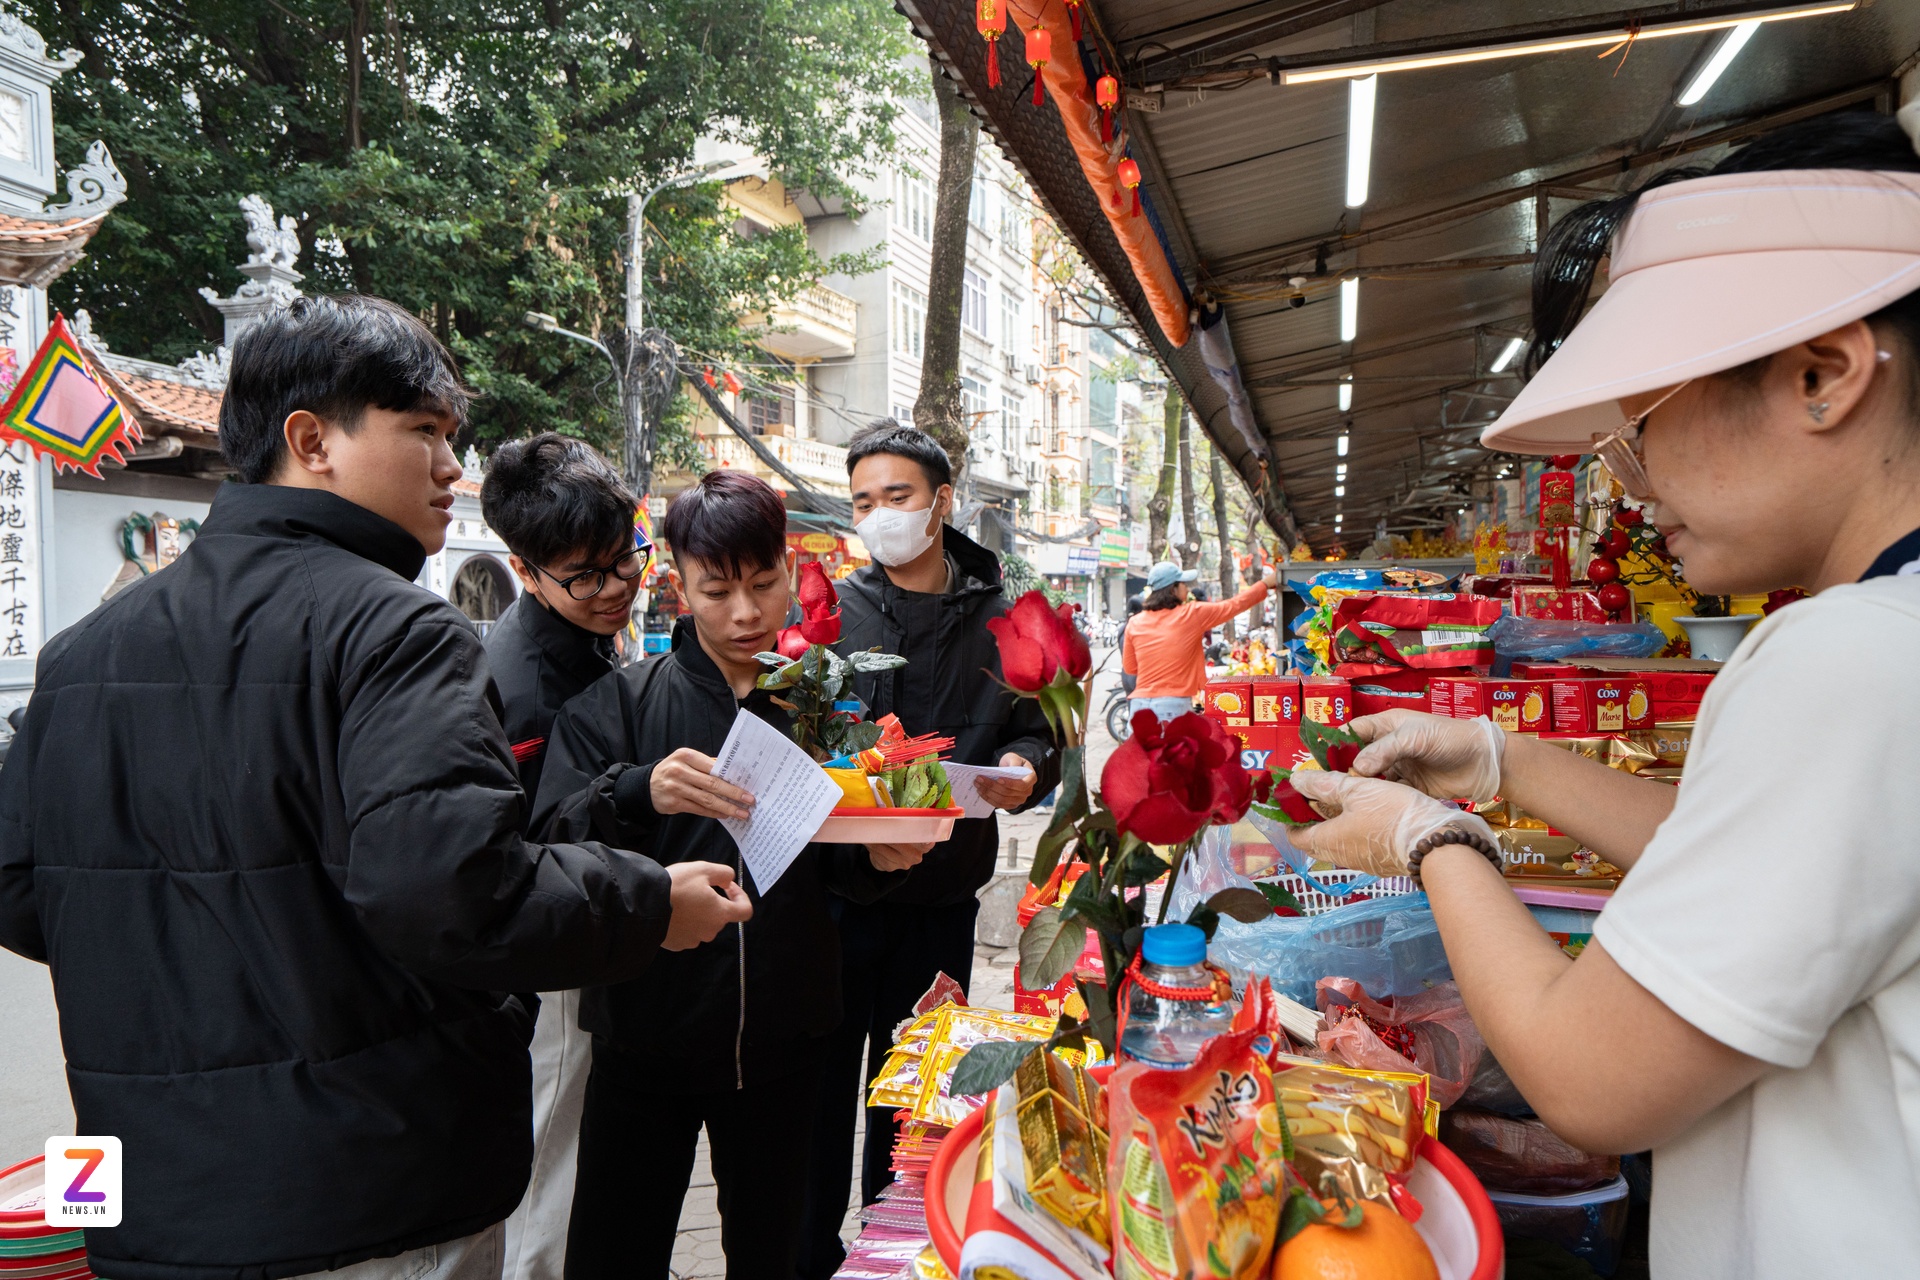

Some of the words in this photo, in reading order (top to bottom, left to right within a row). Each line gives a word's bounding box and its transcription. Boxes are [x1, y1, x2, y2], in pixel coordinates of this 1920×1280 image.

[1492, 690, 1517, 700] COSY
[1597, 688, 1621, 699] COSY
[1282, 695, 1293, 721] COSY
[1334, 696, 1345, 722] COSY
[1657, 737, 1691, 753] Sat
[1241, 750, 1273, 771] SY
[1501, 846, 1546, 865] turn
